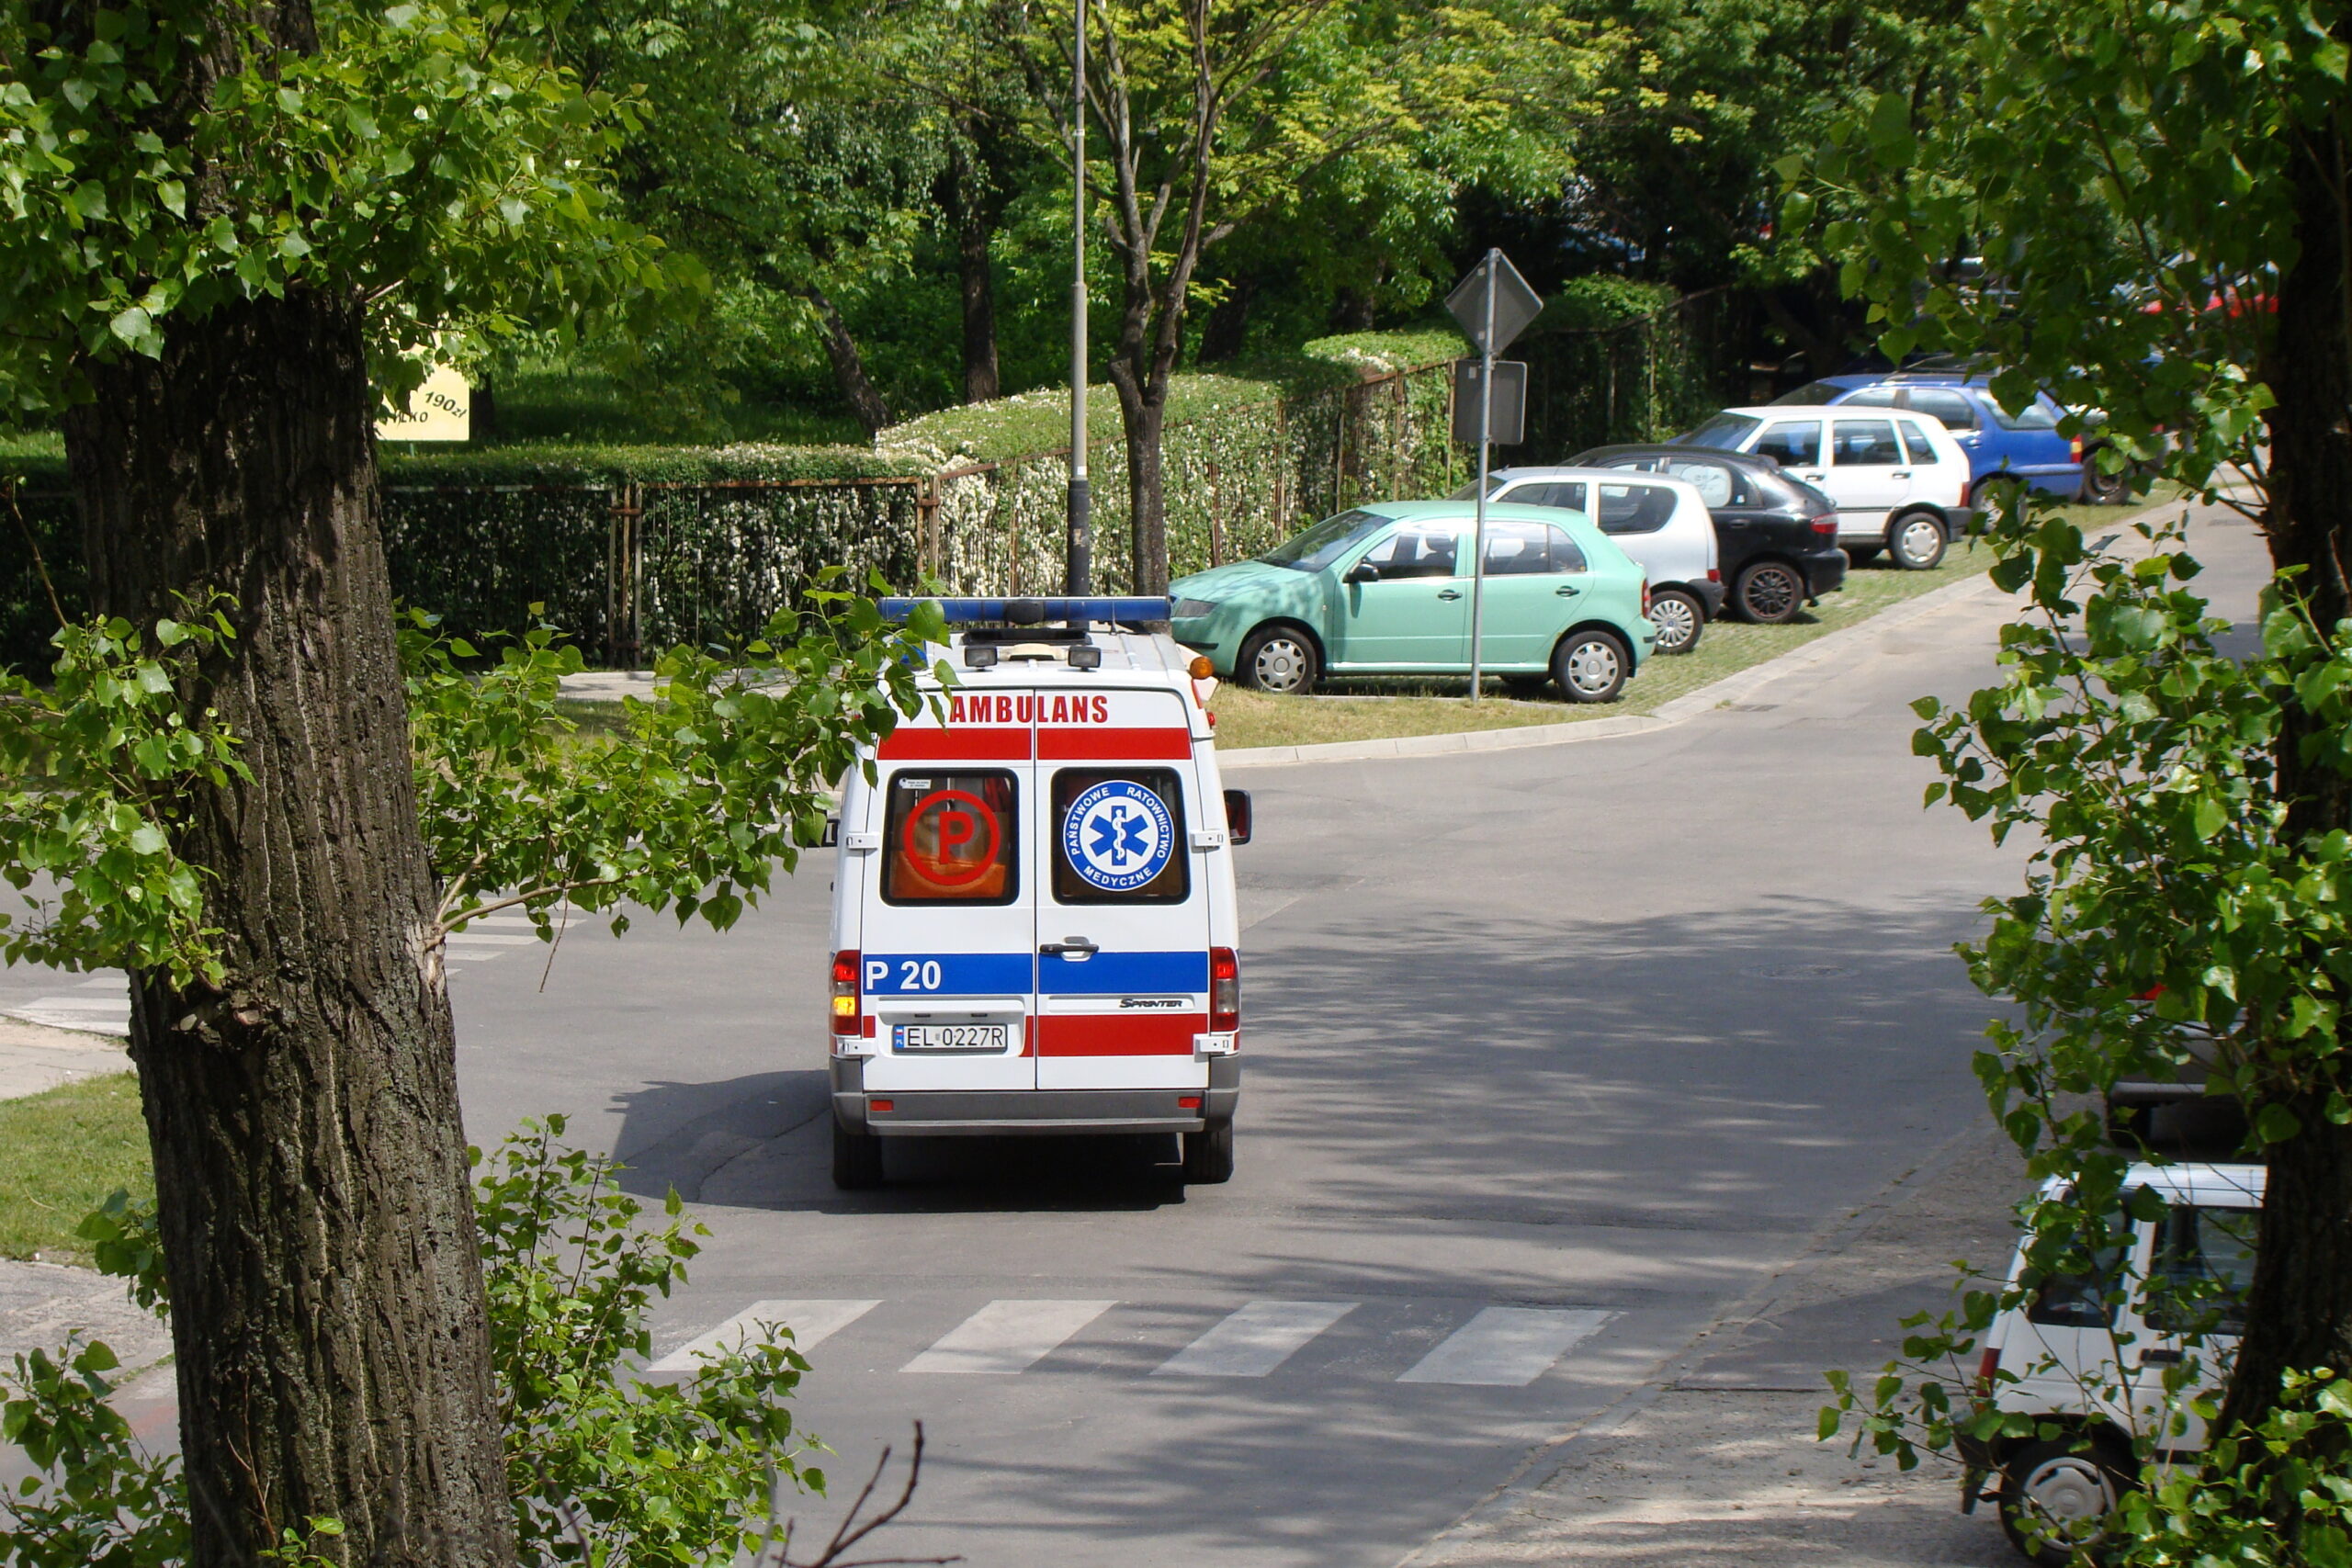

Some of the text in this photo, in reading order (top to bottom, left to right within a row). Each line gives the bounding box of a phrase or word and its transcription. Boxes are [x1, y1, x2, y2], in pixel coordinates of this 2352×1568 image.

[949, 695, 1108, 724] AMBULANS
[1067, 786, 1170, 859] PAŃSTWOWE RATOWNICTWO
[940, 811, 974, 864] P
[1084, 865, 1153, 886] MEDYCZNE
[866, 961, 942, 990] P 20
[908, 1028, 1003, 1046] EL 0227R
